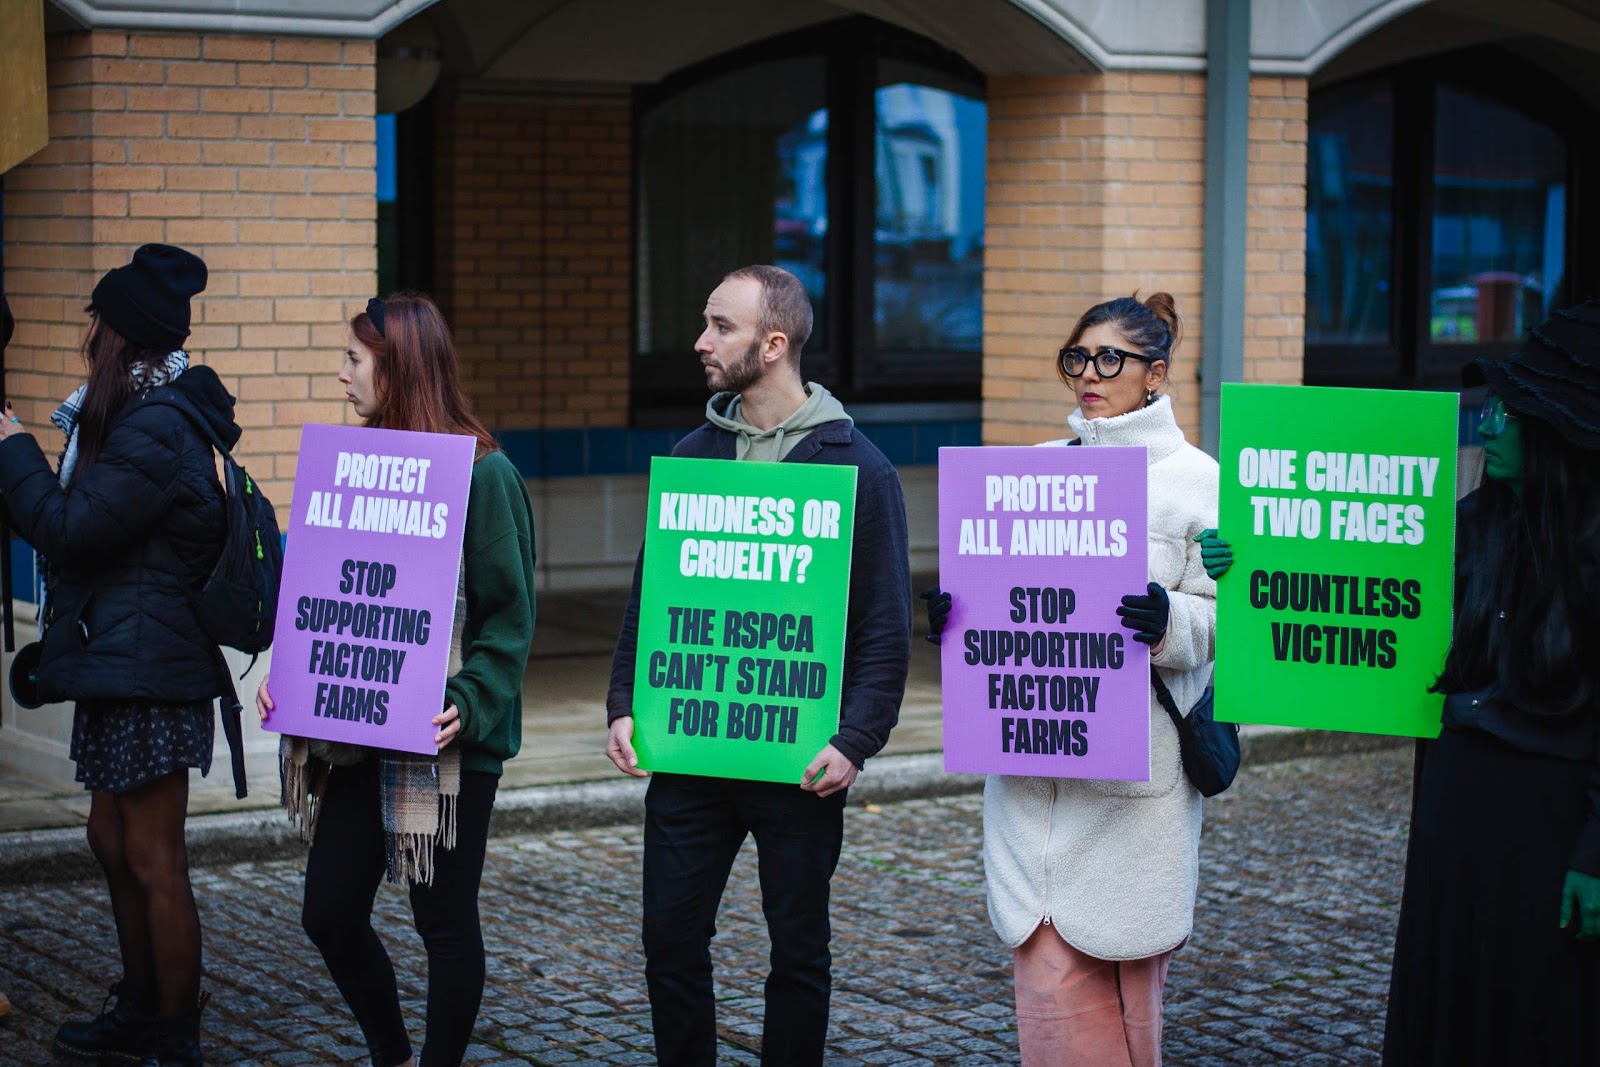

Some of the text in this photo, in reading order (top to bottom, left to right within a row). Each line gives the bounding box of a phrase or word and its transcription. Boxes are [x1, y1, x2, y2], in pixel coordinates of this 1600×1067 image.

[334, 451, 431, 494] PROTECT
[985, 475, 1098, 512] PROTECT
[1238, 447, 1440, 497] ONE CHARITY
[305, 491, 448, 539] ALL ANIMALS
[659, 492, 841, 539] KINDNESS OR
[1251, 496, 1425, 545] TWO FACES
[679, 538, 813, 584] CRUELTY?
[958, 519, 1128, 558] ALL ANIMALS
[339, 559, 396, 596] STOP
[1249, 570, 1421, 619] COUNTLESS
[295, 595, 431, 645] SUPPORTING
[1009, 587, 1076, 624] STOP
[668, 607, 814, 653] THE RSPCA
[964, 629, 1124, 670] SUPPORTING
[1271, 622, 1397, 669] VICTIMS
[309, 641, 406, 684] FACTORY
[649, 651, 827, 700] CAN'T STAND
[314, 682, 389, 726] FARMS
[988, 674, 1100, 713] FACTORY
[668, 698, 799, 744] FOR BOTH
[1002, 718, 1088, 756] FARMS
